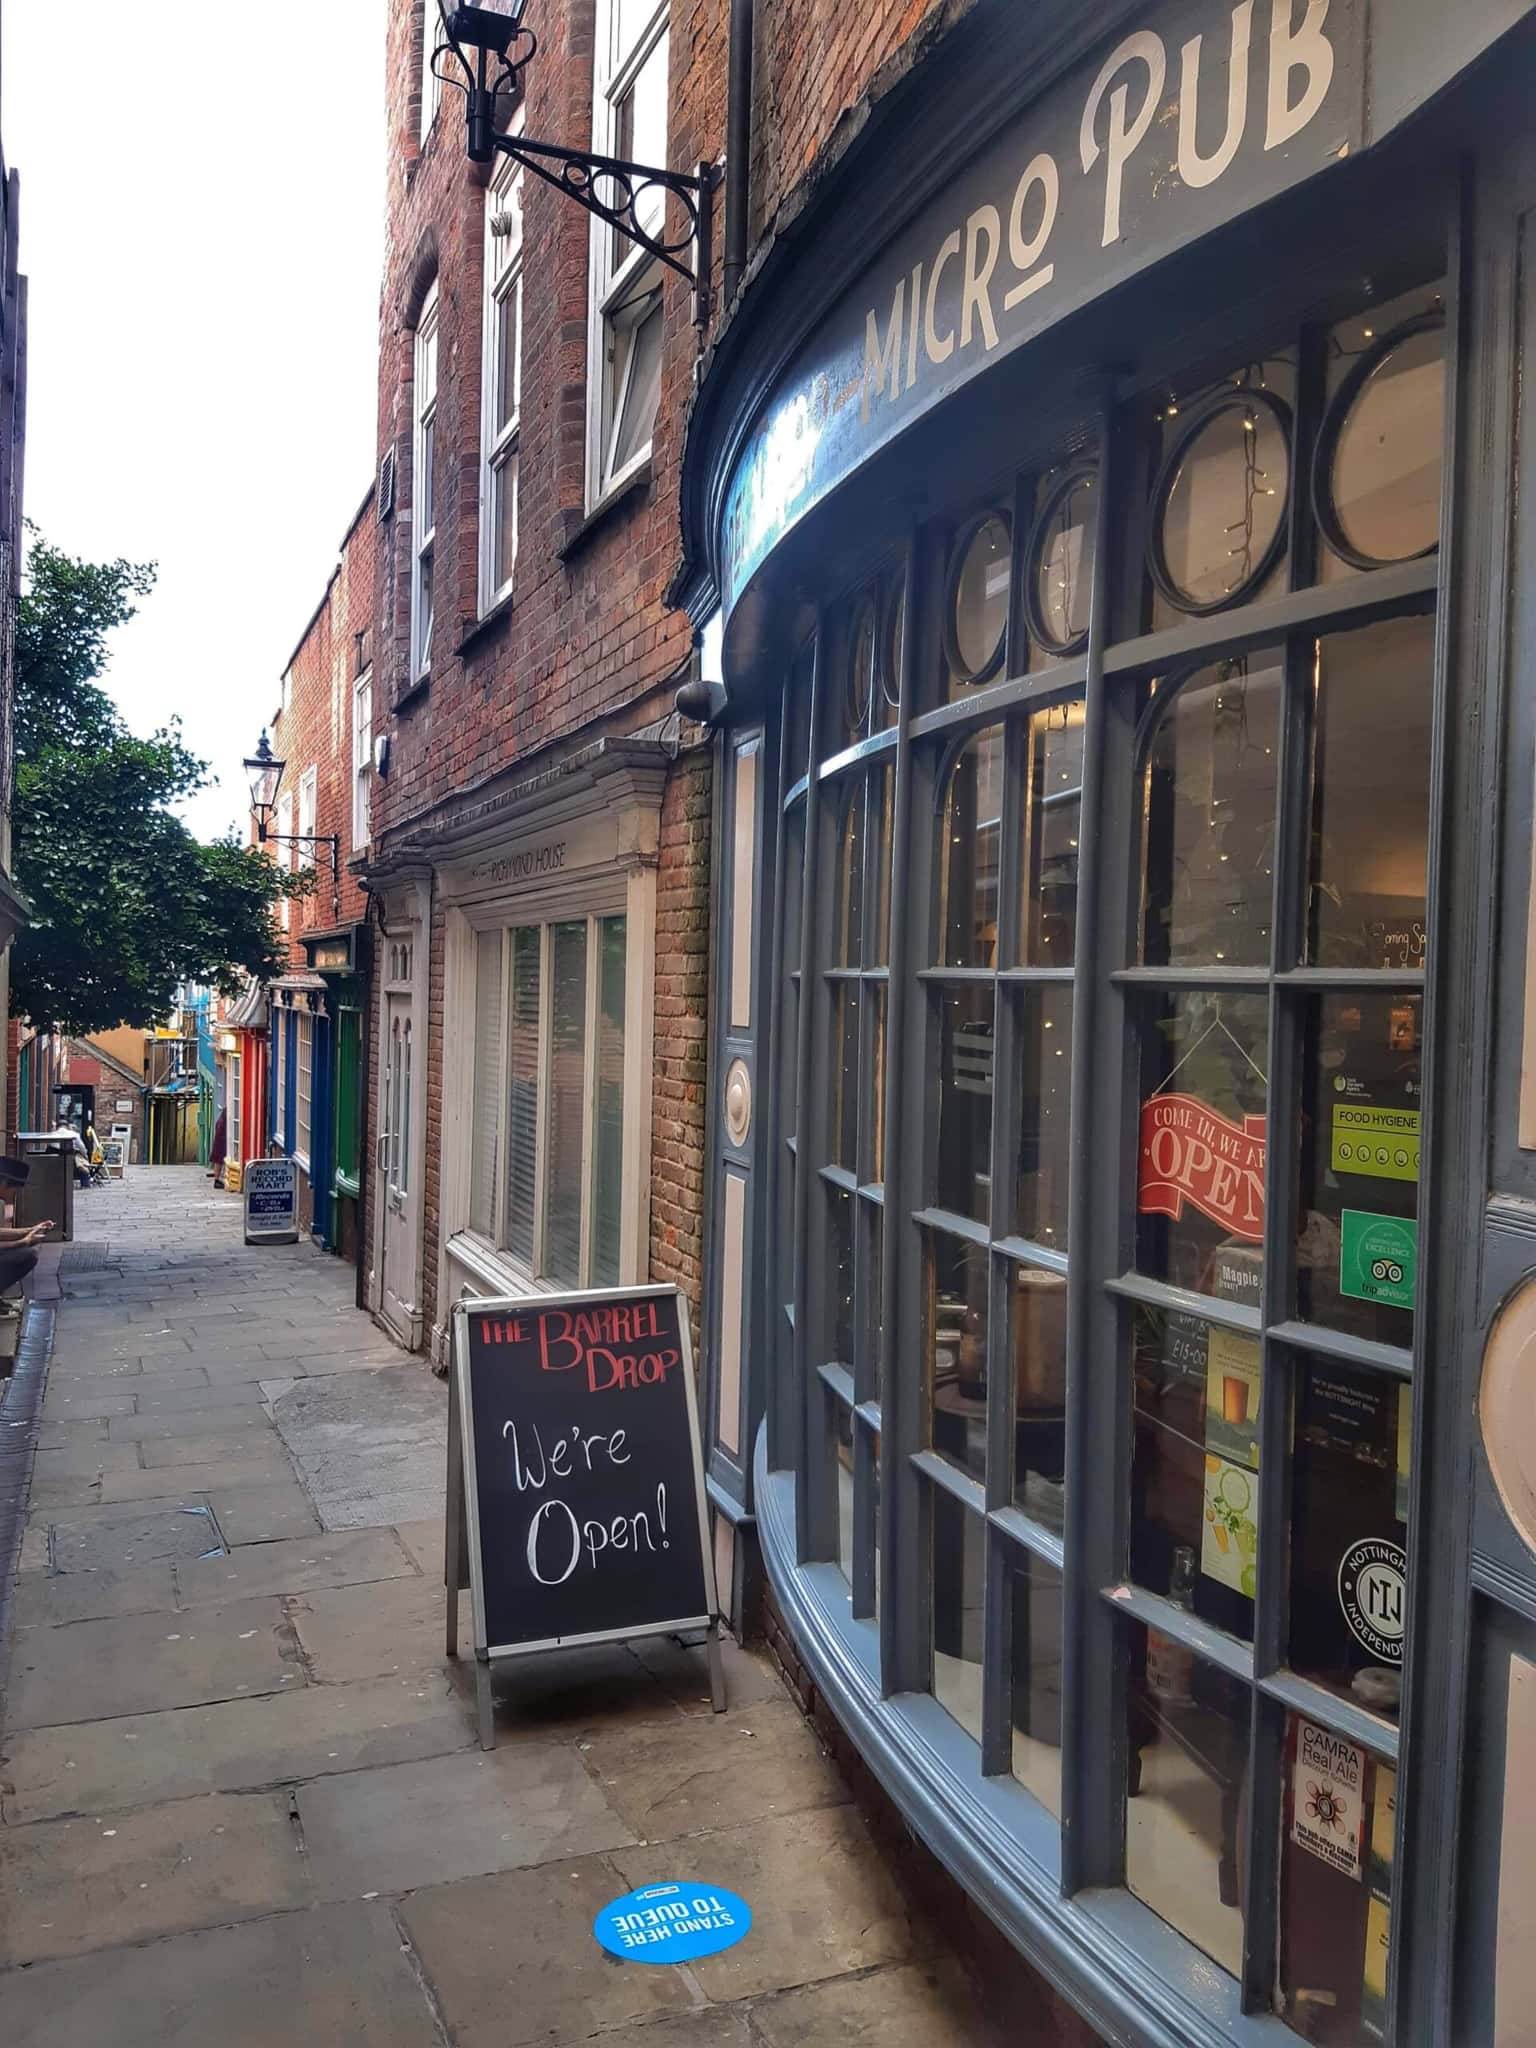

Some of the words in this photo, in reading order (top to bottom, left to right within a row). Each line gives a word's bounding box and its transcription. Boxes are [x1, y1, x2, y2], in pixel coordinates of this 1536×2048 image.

[860, 153, 1061, 425] MICRO
[1079, 0, 1335, 248] PUB
[535, 842, 567, 873] HOUSE
[1154, 1107, 1193, 1129] COME
[1197, 1117, 1216, 1147] IN,
[1220, 1134, 1242, 1160] WE
[1340, 1111, 1370, 1124] FOOD
[1372, 1114, 1418, 1129] HYGIENE
[251, 1175, 293, 1184] RECORD
[256, 1168, 288, 1176] ROB'S
[1151, 1127, 1266, 1222] OPEN
[1365, 1242, 1411, 1257] EXCELLENCE
[1222, 1265, 1258, 1287] Magpie
[480, 1318, 533, 1345] THE
[538, 1303, 671, 1370] BARREL
[585, 1348, 680, 1392] DROP
[502, 1420, 631, 1491] We're
[527, 1482, 670, 1585] Open!
[1303, 1727, 1359, 1768] CAMRA
[1302, 1743, 1332, 1771] Real
[1337, 1759, 1358, 1784] Ale
[611, 1903, 690, 1933] QUEUE
[692, 1896, 726, 1914] TO
[620, 1925, 671, 1948] HERE
[675, 1913, 735, 1934] STAND
